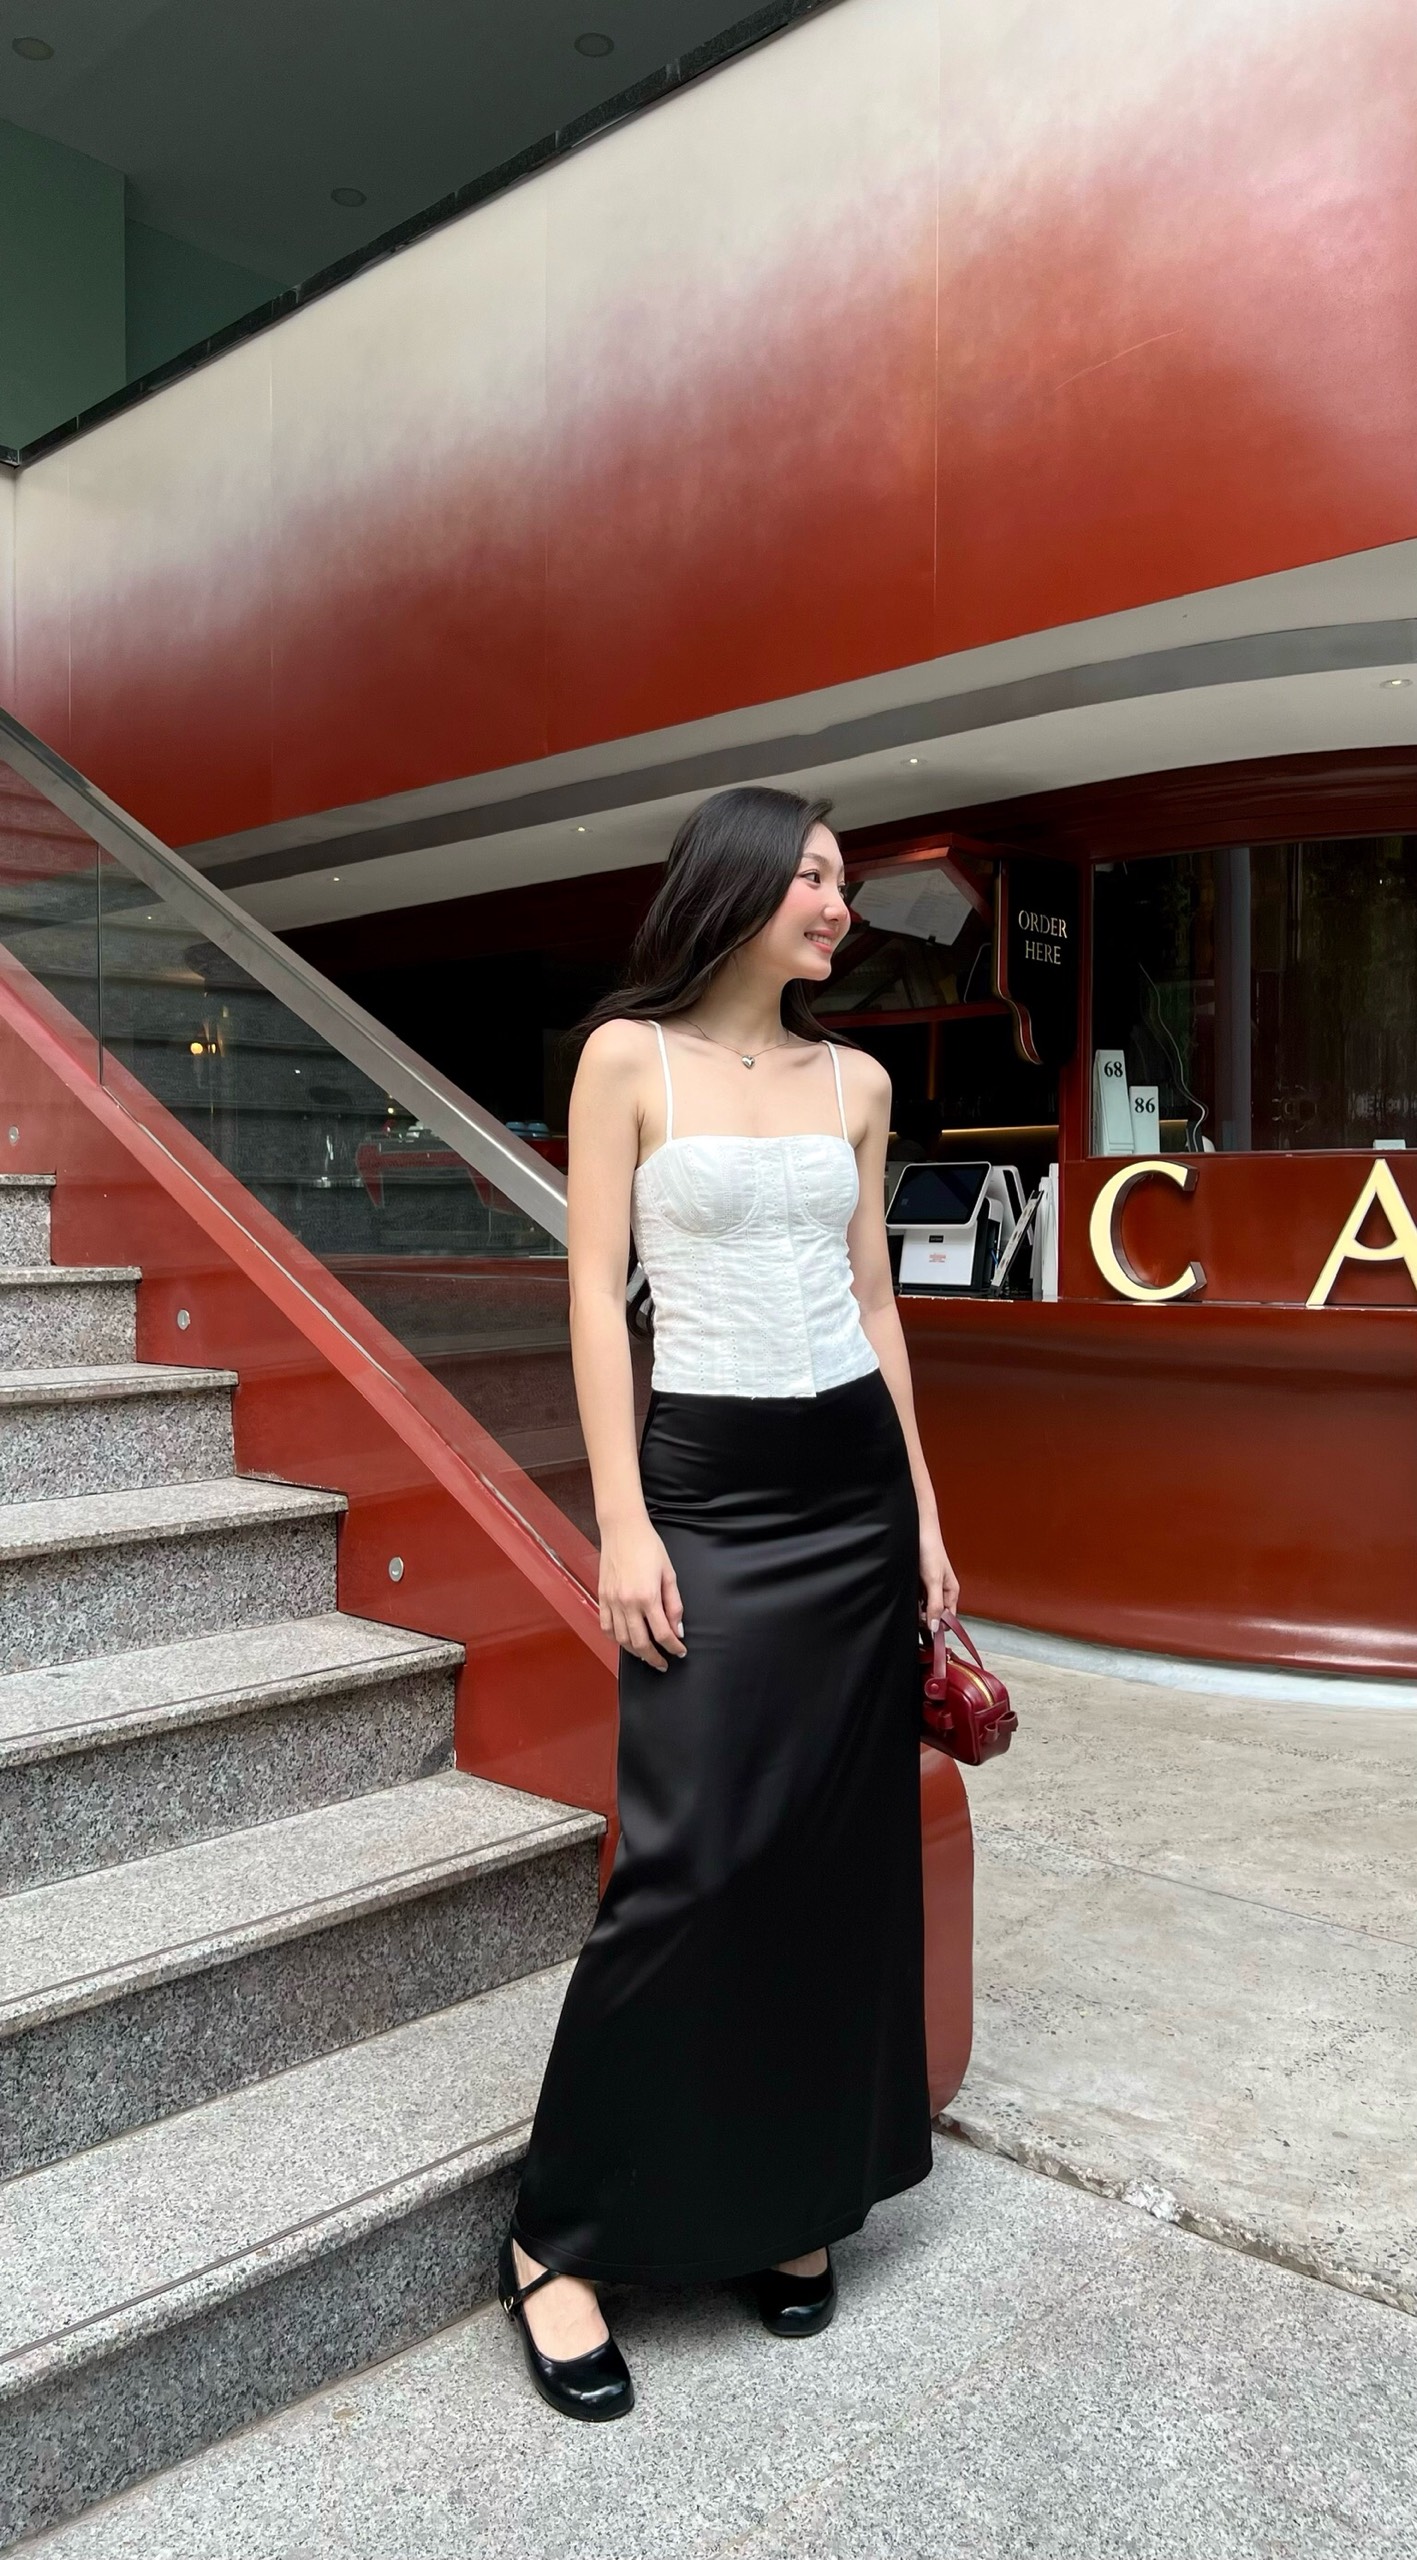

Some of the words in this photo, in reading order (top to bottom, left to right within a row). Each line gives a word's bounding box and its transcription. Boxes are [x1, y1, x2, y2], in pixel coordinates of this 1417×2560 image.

[1018, 909, 1068, 939] ORDER
[1025, 939, 1062, 965] HERE
[1103, 1060, 1124, 1078] 68
[1134, 1097, 1156, 1114] 86
